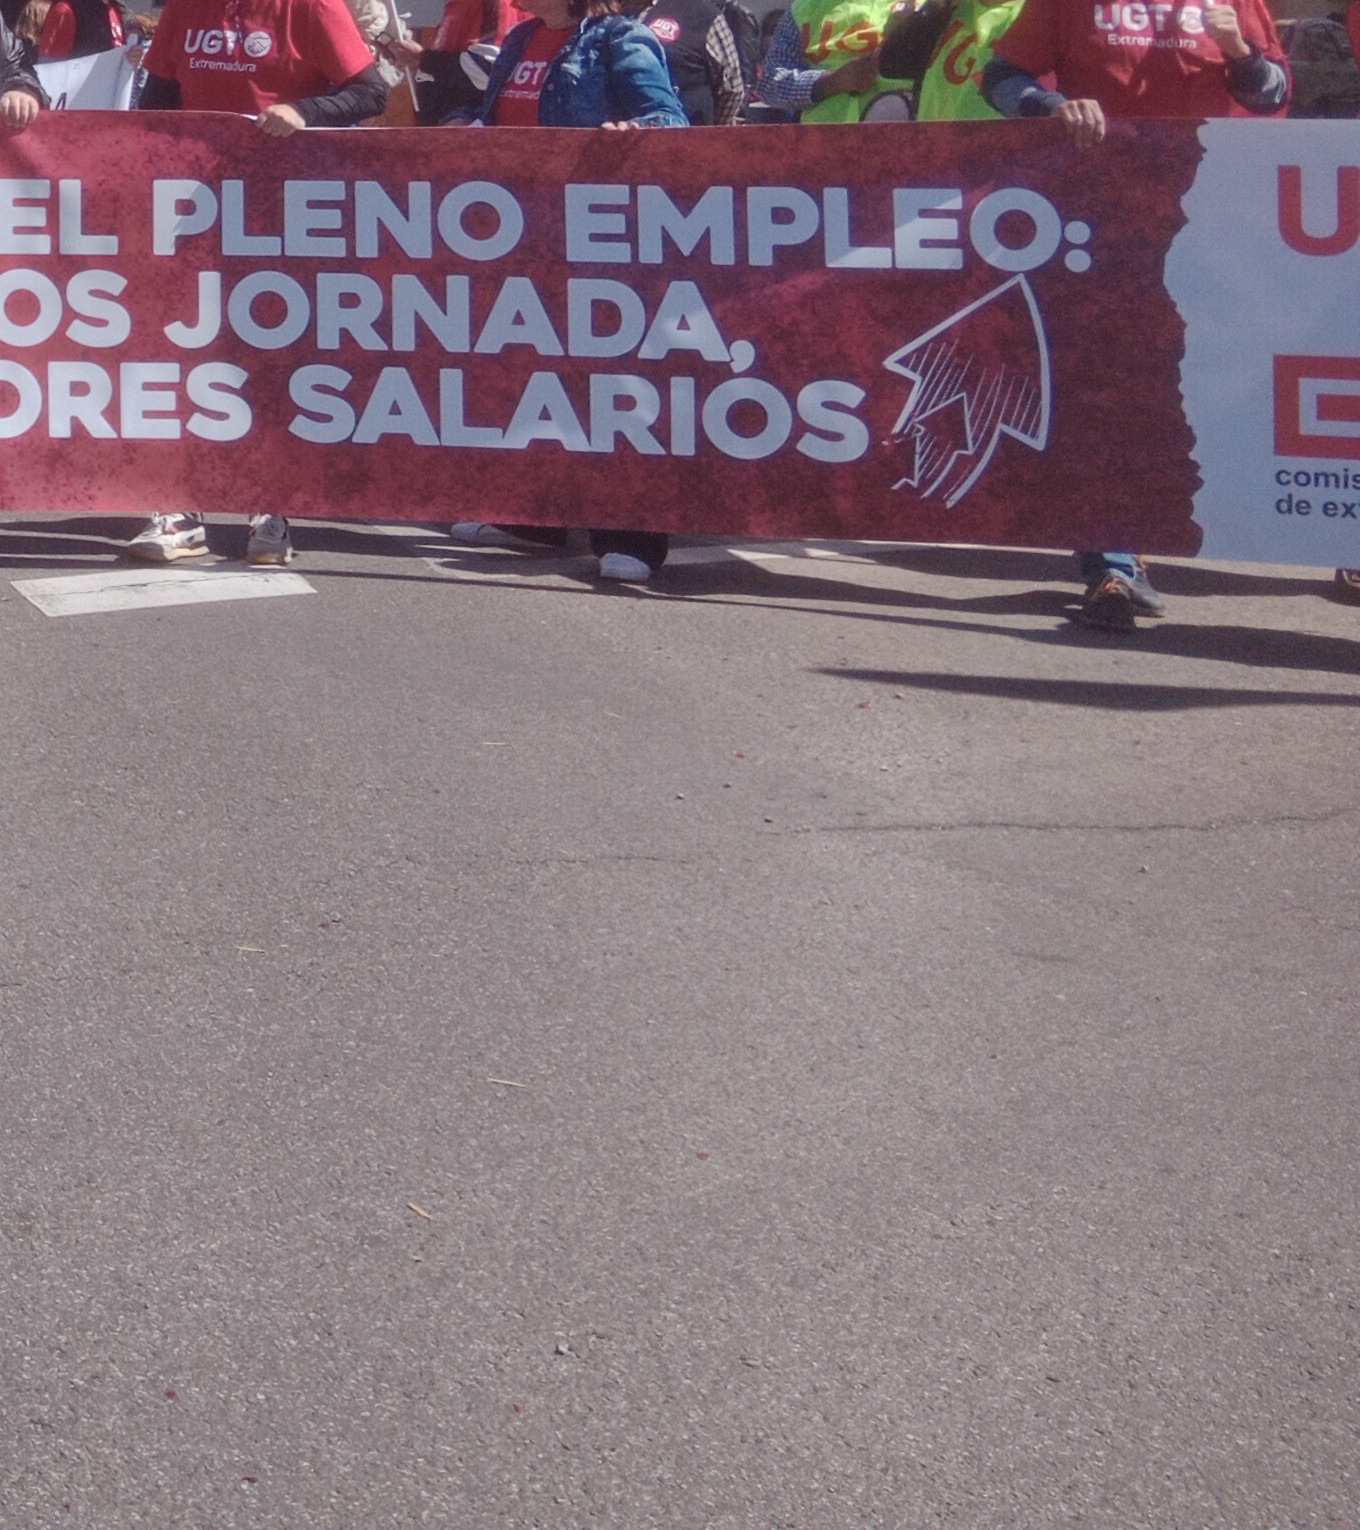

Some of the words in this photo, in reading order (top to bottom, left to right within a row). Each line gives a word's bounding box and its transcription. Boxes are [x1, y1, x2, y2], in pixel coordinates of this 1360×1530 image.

[1094, 2, 1173, 32] UGT
[183, 28, 238, 56] UGT
[189, 57, 257, 73] Extremadura
[153, 178, 524, 261] PLENO
[565, 182, 1092, 273] EMPLEO:
[163, 271, 756, 374] JORNADA,
[288, 364, 871, 463] SALARIOS
[1275, 493, 1312, 515] de
